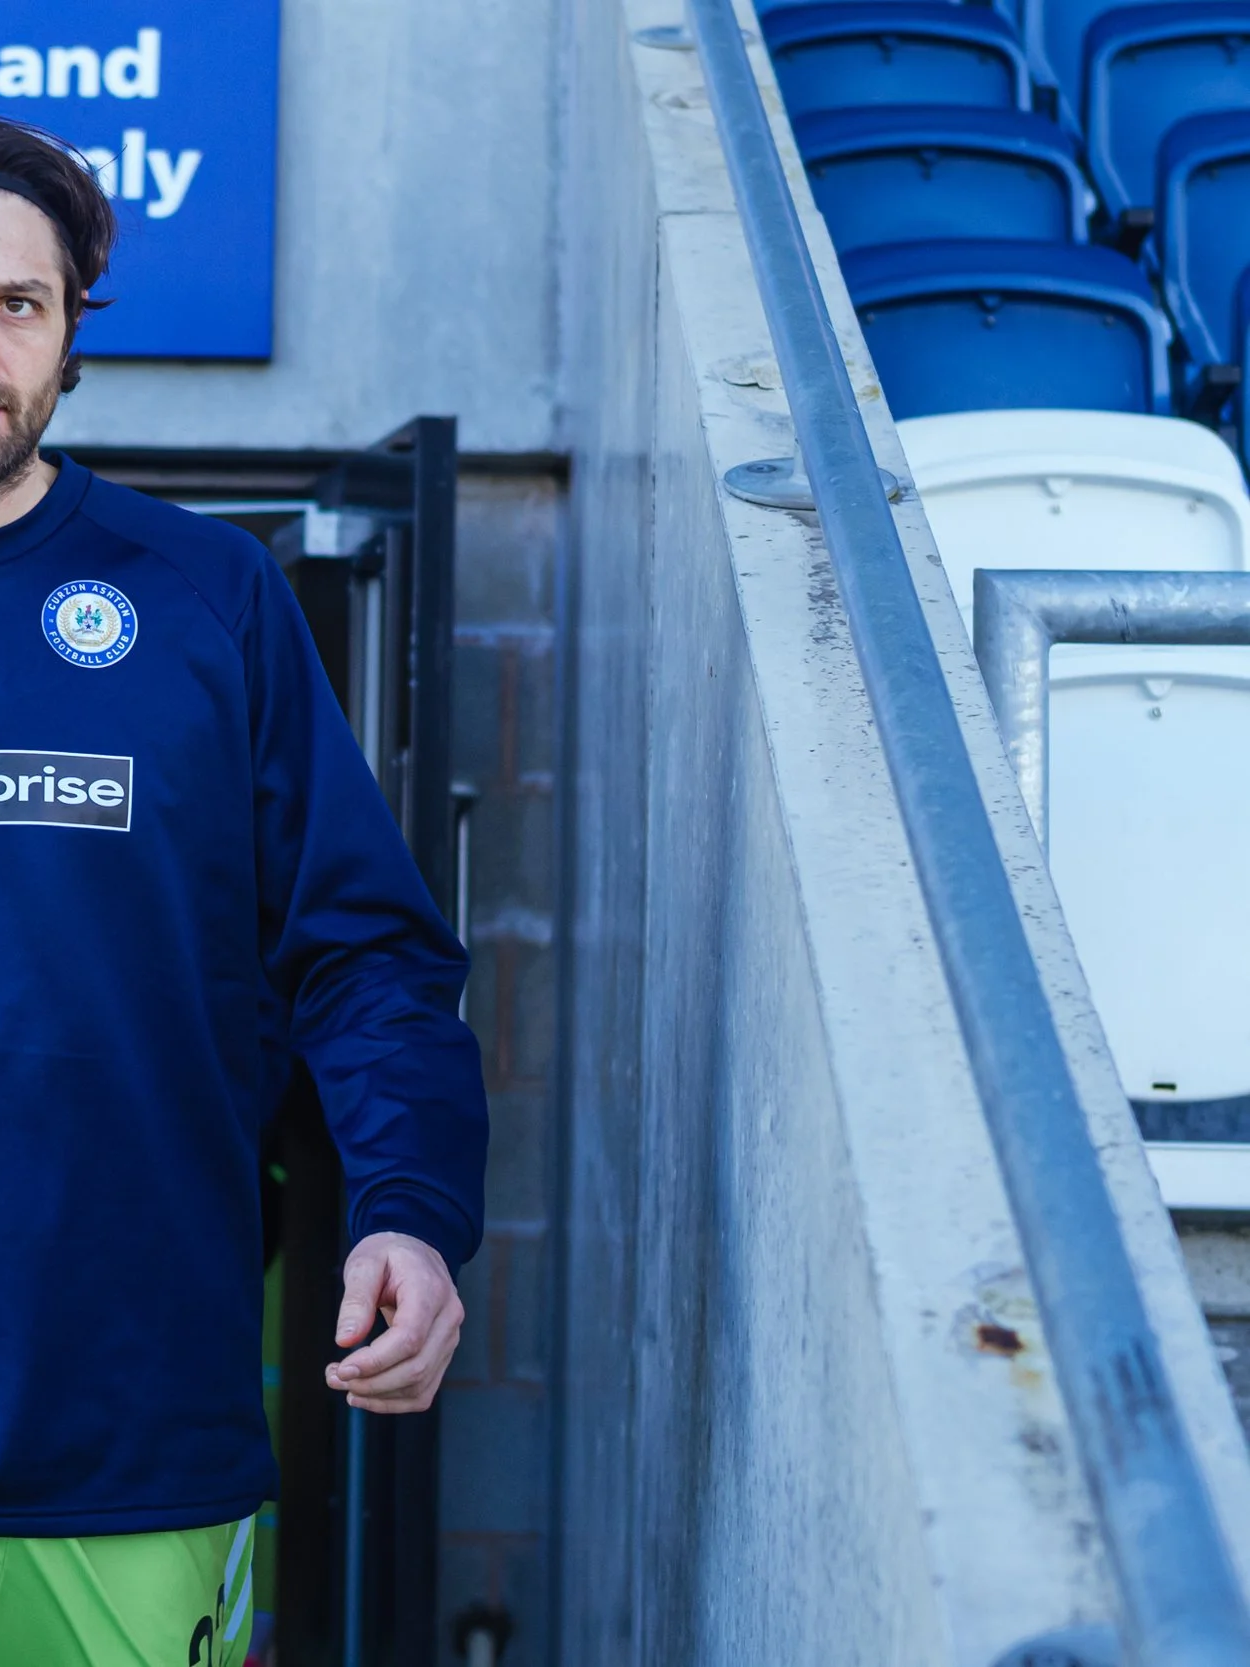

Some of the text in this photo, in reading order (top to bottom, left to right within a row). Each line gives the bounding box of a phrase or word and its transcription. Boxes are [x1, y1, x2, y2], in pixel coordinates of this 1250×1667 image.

[66, 127, 203, 219] nly
[47, 583, 131, 617] CURZON ASHTON
[49, 631, 130, 664] FOOTBALL CLUB
